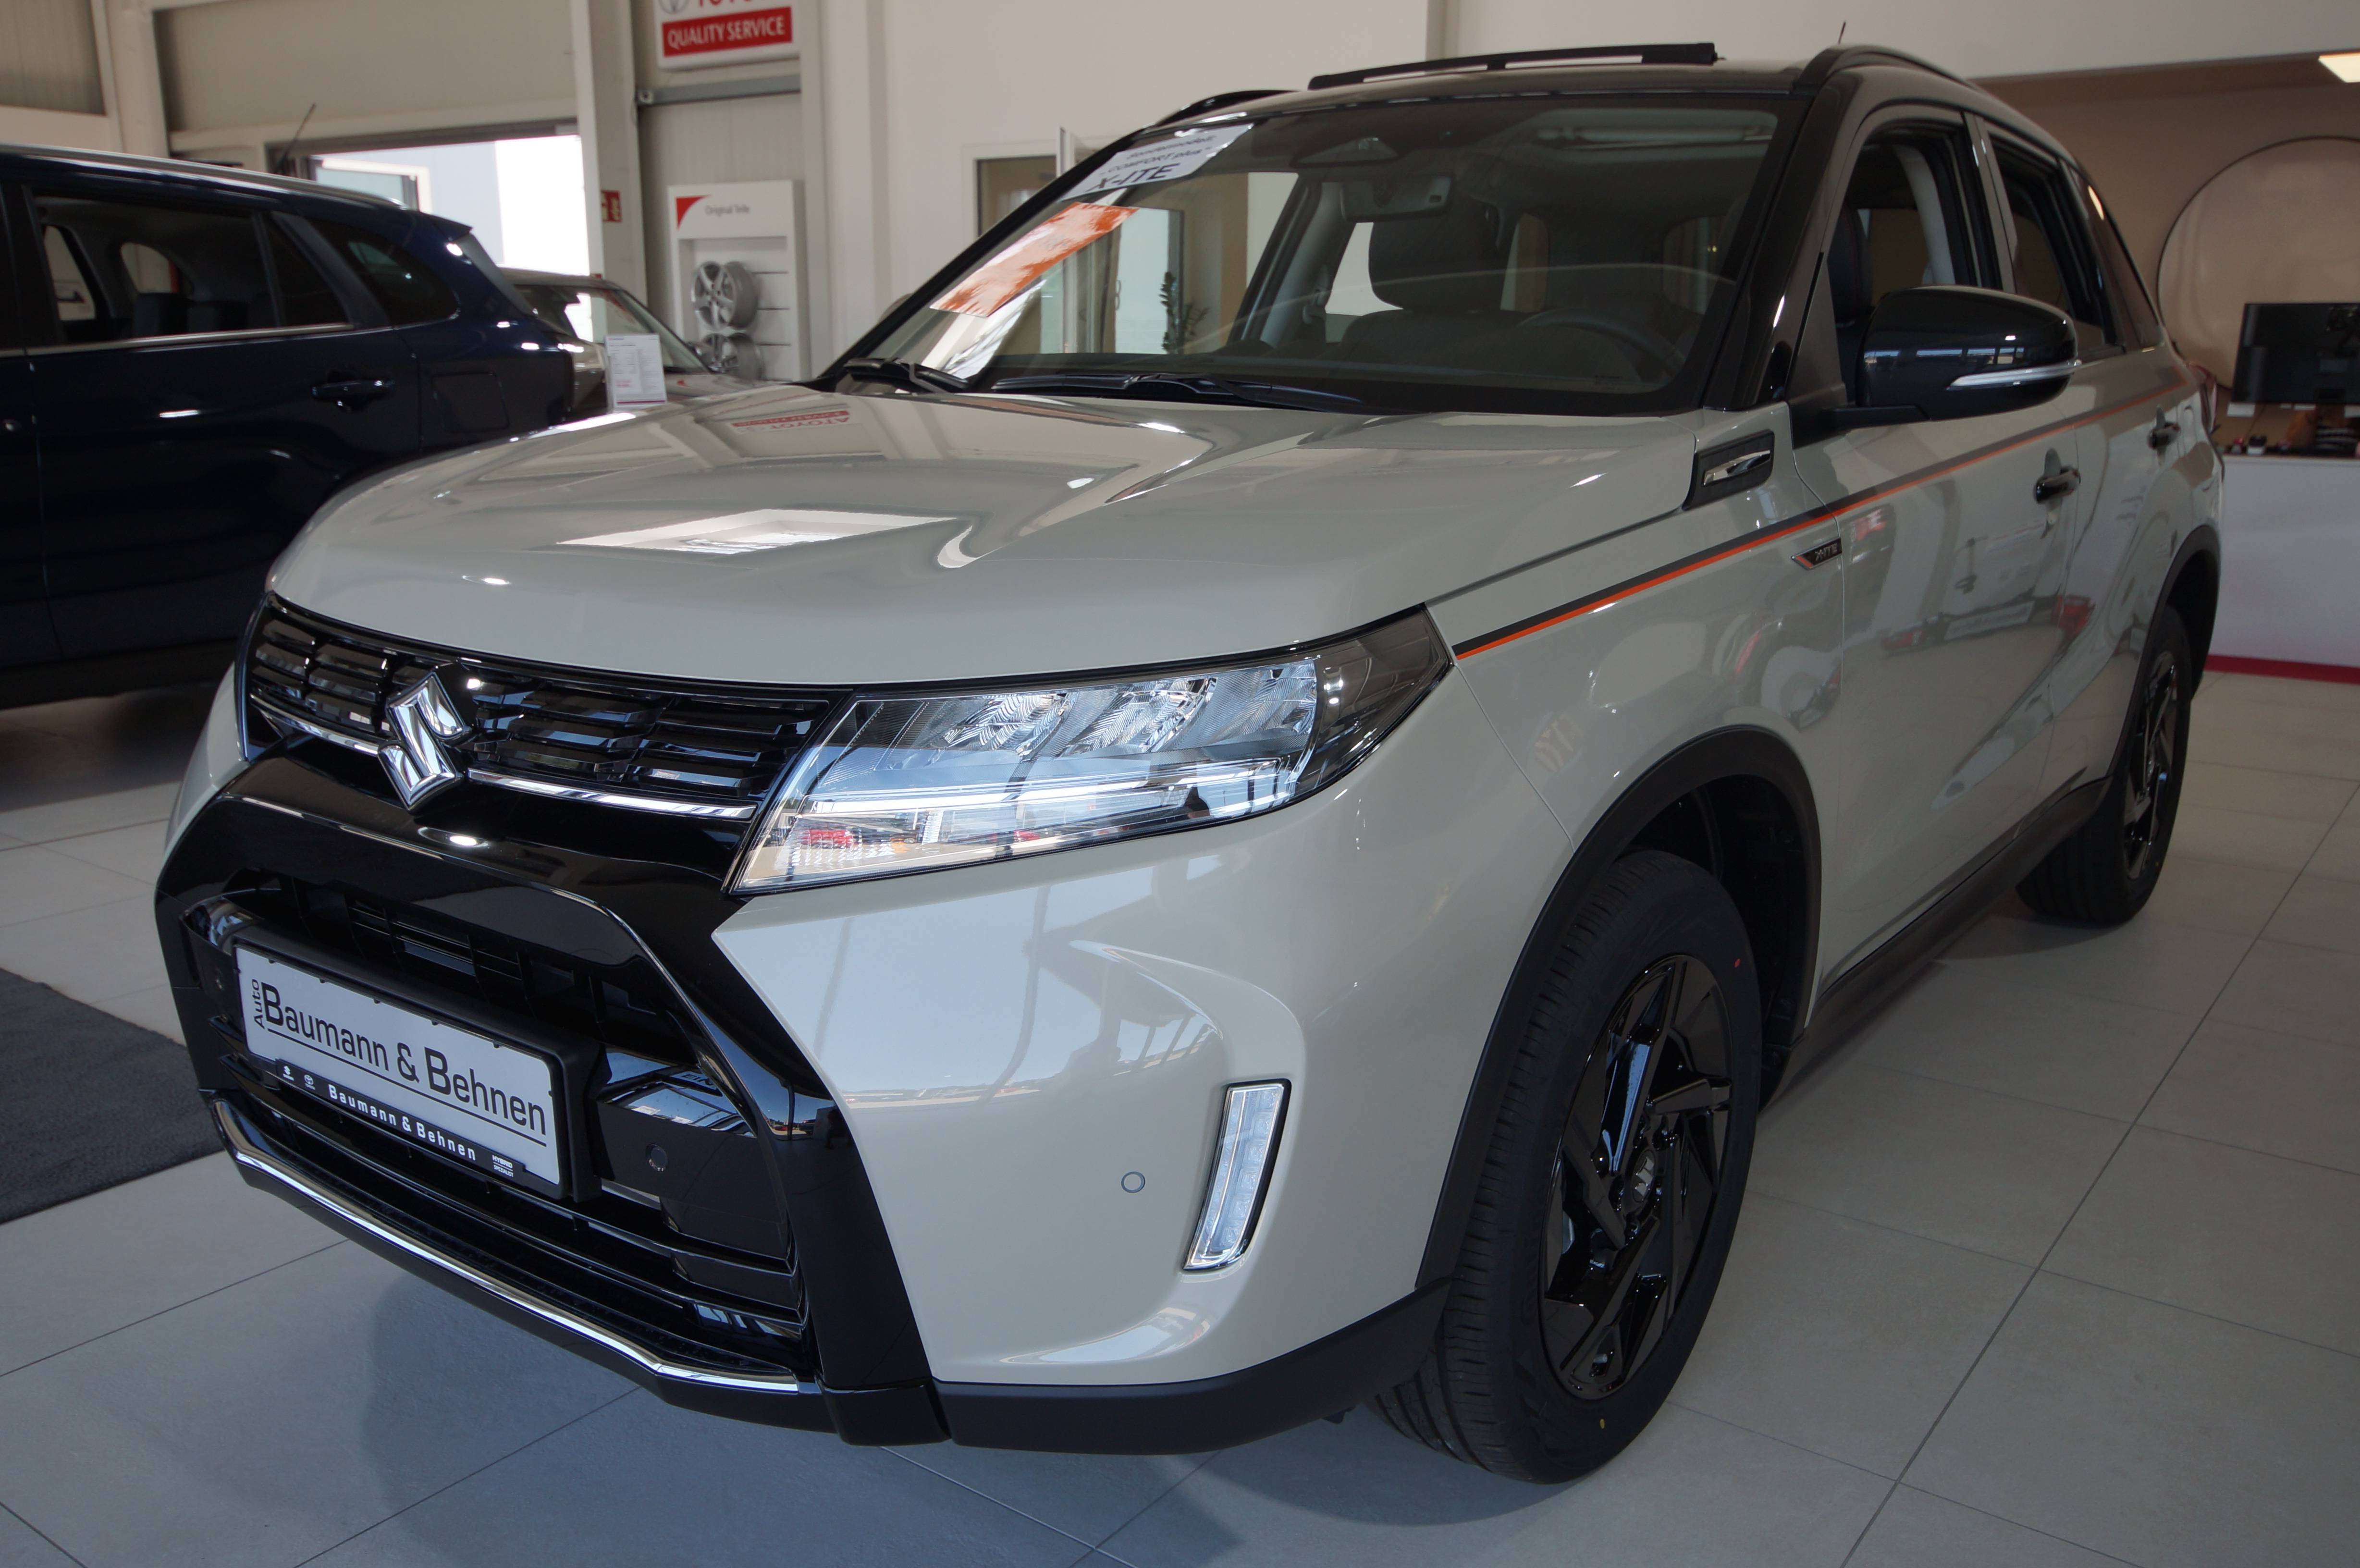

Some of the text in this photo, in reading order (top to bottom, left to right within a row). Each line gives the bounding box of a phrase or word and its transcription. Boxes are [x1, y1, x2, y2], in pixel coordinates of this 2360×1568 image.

[667, 16, 786, 50] QUALITY SERVICE
[1084, 162, 1180, 193] X-ITE
[251, 979, 265, 1029] Auto
[261, 981, 546, 1136] Baumann & Behnen
[328, 1083, 476, 1161] Baumann & Behnen
[492, 1154, 513, 1168] HYBRID
